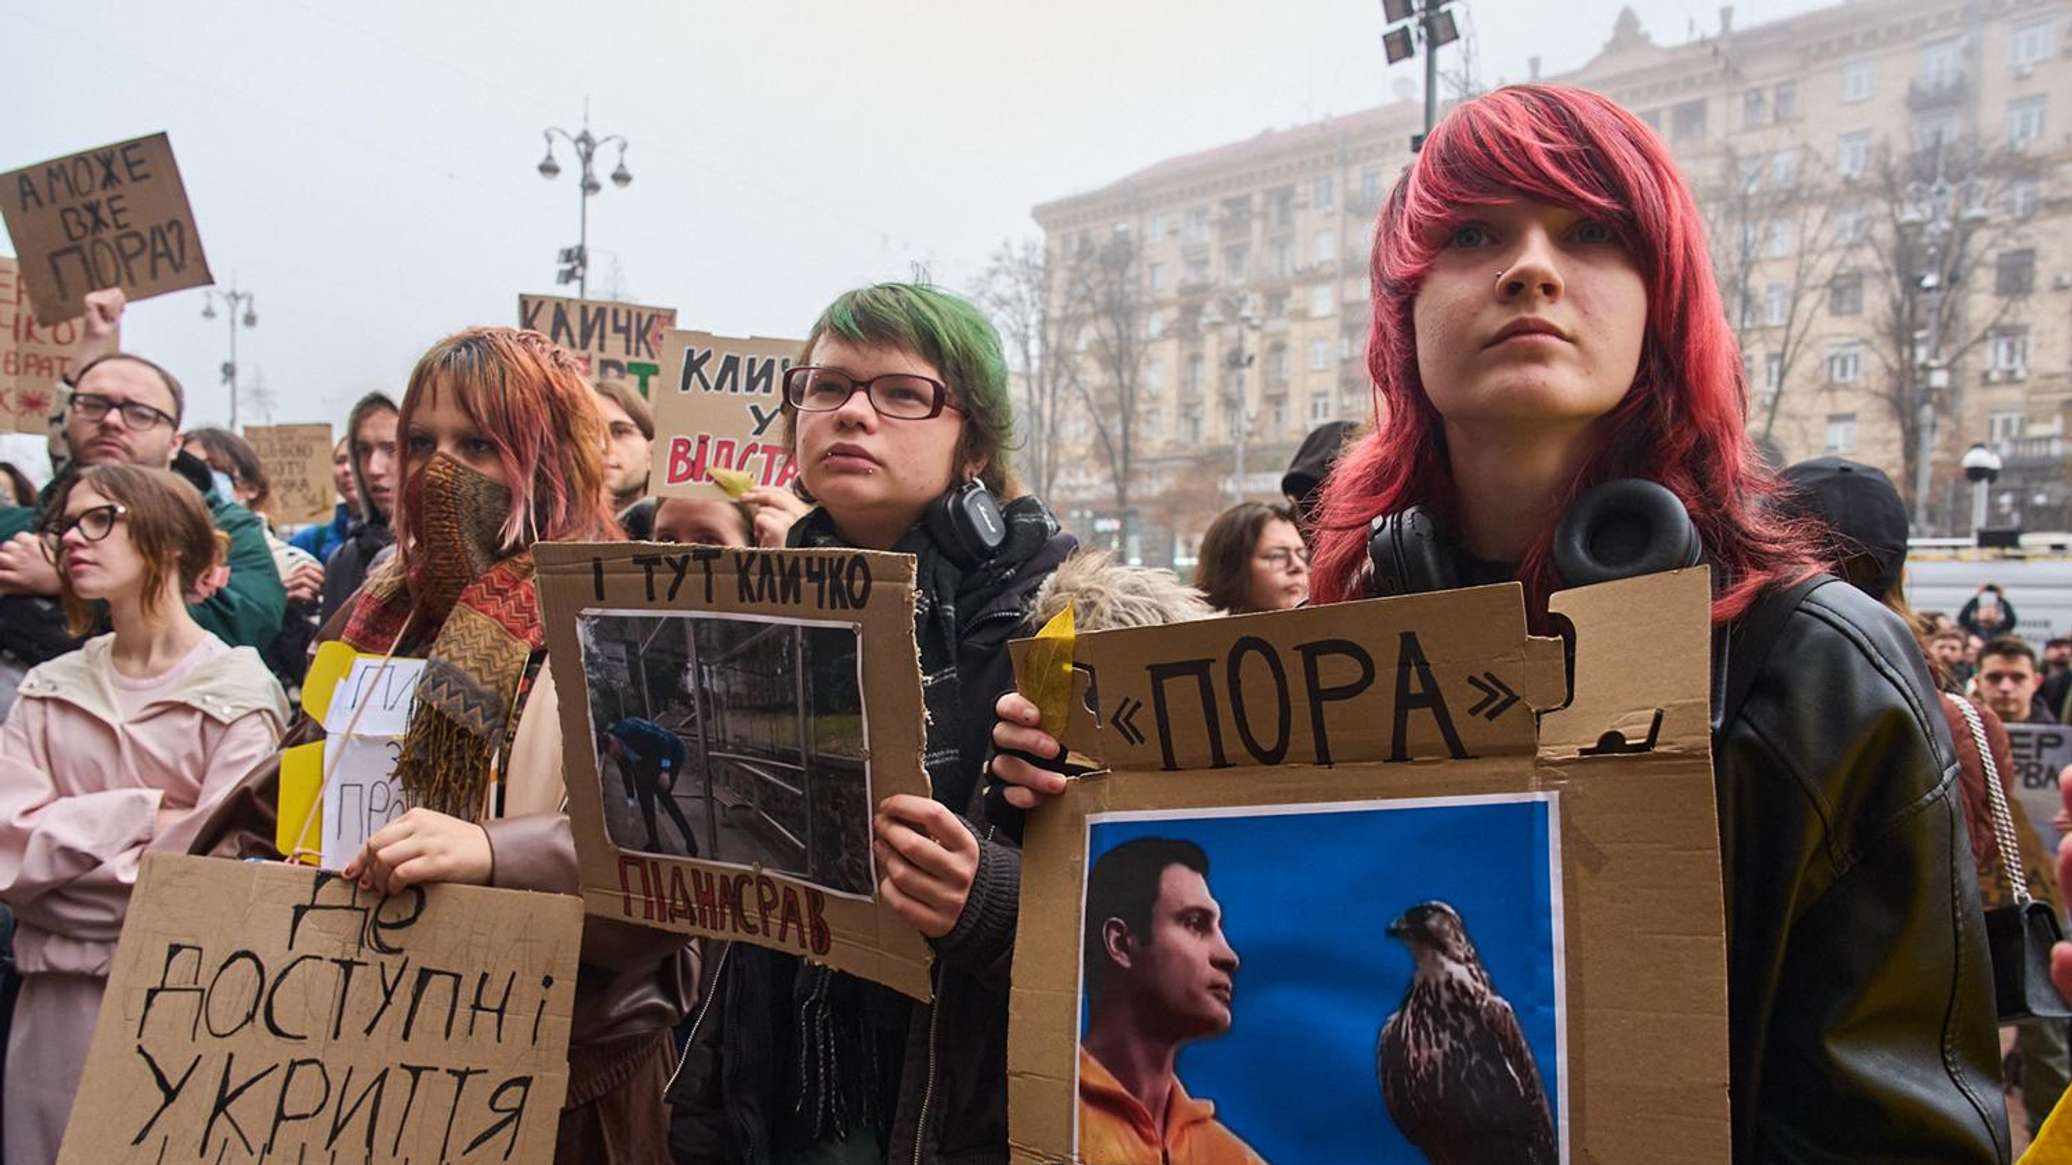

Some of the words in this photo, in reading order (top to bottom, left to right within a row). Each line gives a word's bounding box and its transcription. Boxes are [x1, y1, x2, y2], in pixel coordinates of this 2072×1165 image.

[18, 170, 40, 212] А
[50, 145, 151, 203] МОЖЕ
[60, 195, 130, 243] ВЖЕ
[48, 220, 187, 301] ПОРА?
[749, 404, 786, 436] У
[592, 556, 606, 601] І
[632, 550, 722, 603] ТУТ
[734, 551, 873, 610] КЛИЧКО
[1109, 631, 1521, 771] «ПОРА»
[131, 1044, 534, 1159] УКРИТТЯ
